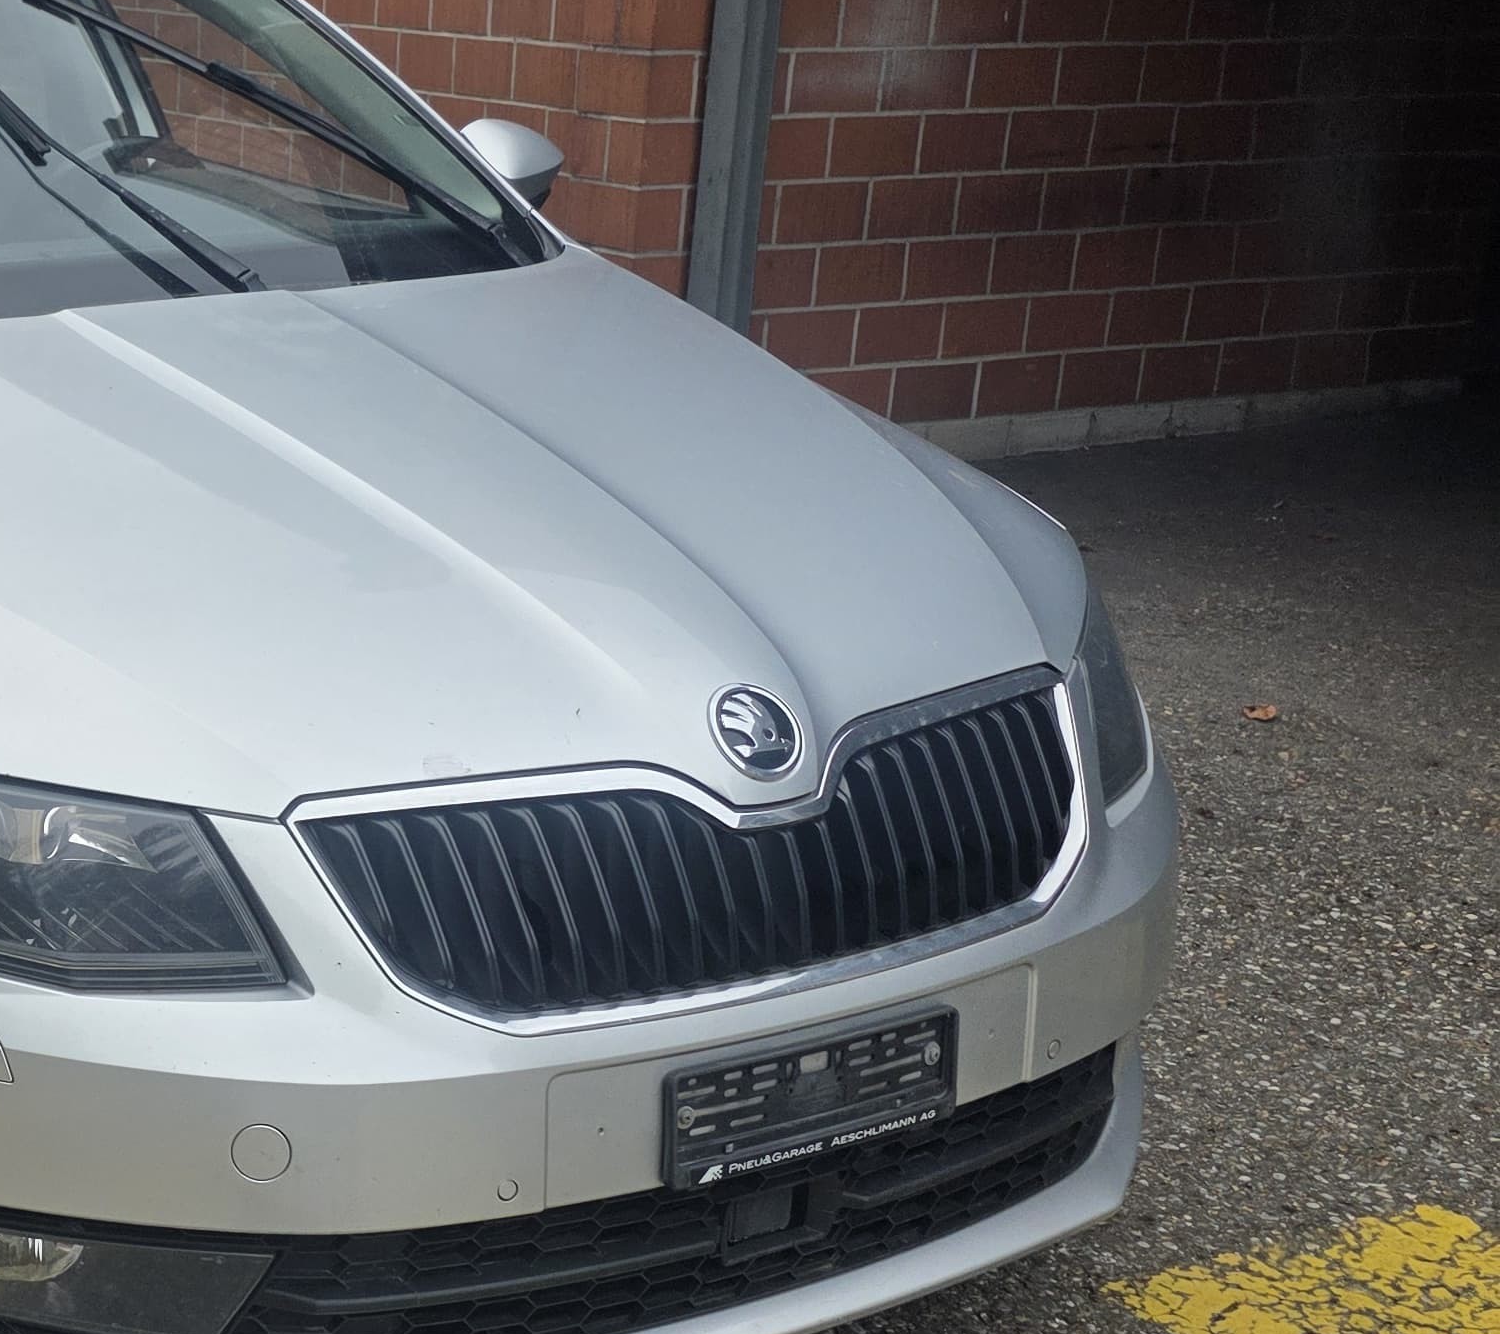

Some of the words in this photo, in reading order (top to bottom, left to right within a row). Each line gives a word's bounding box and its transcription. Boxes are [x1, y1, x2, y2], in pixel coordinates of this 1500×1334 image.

[728, 1141, 823, 1174] PNEU&GARAGE
[830, 1115, 916, 1147] AESCHLIMANN
[919, 1109, 936, 1121] AG
